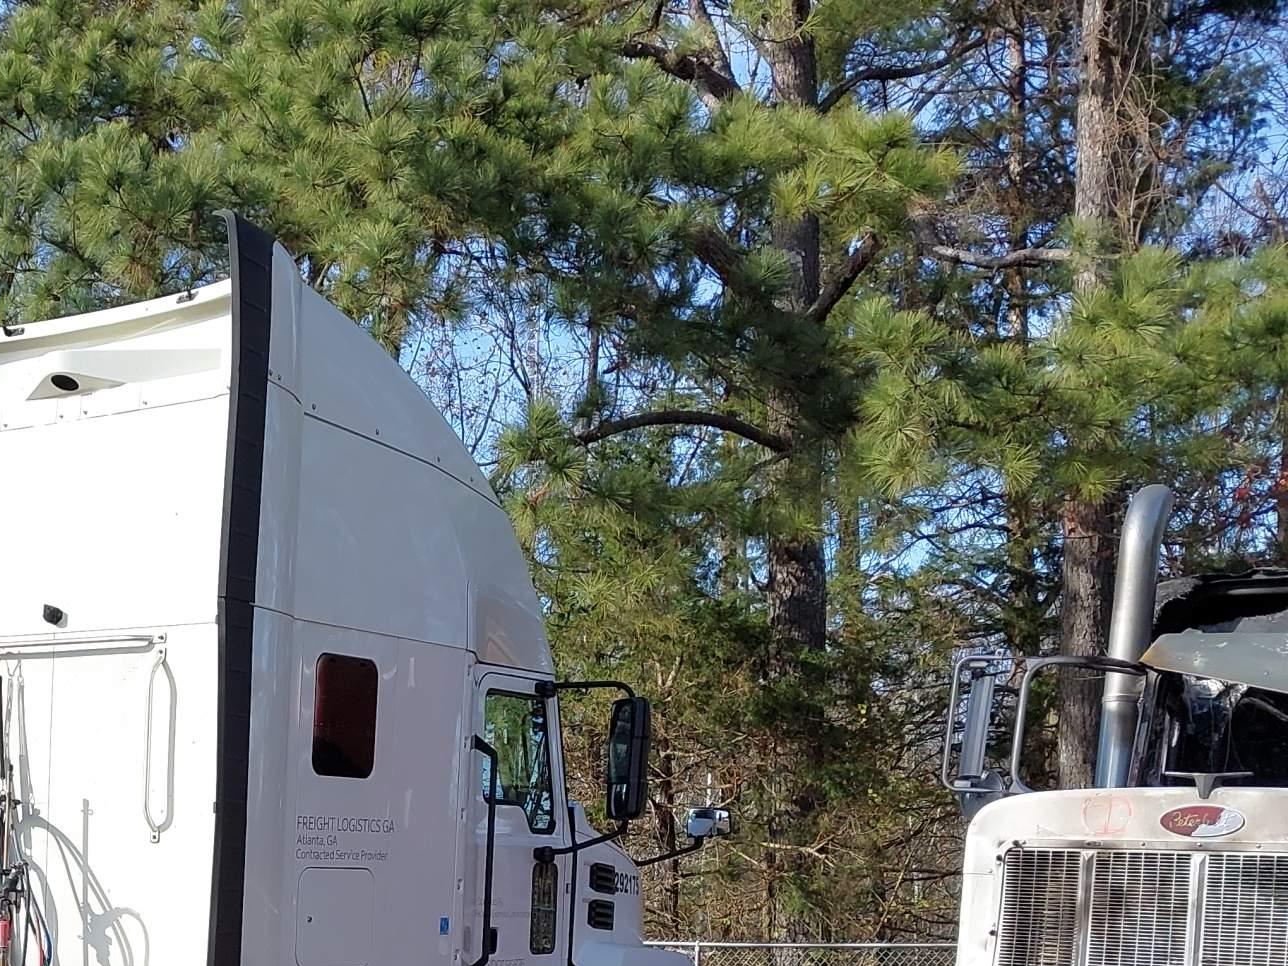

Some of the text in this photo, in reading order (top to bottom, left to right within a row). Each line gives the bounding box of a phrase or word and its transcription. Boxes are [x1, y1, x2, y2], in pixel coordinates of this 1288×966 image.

[297, 815, 395, 833] FREIGHT LOGISTICS GA
[296, 834, 338, 846] Atlanta, GA
[295, 848, 388, 862] Contracted Service Provider
